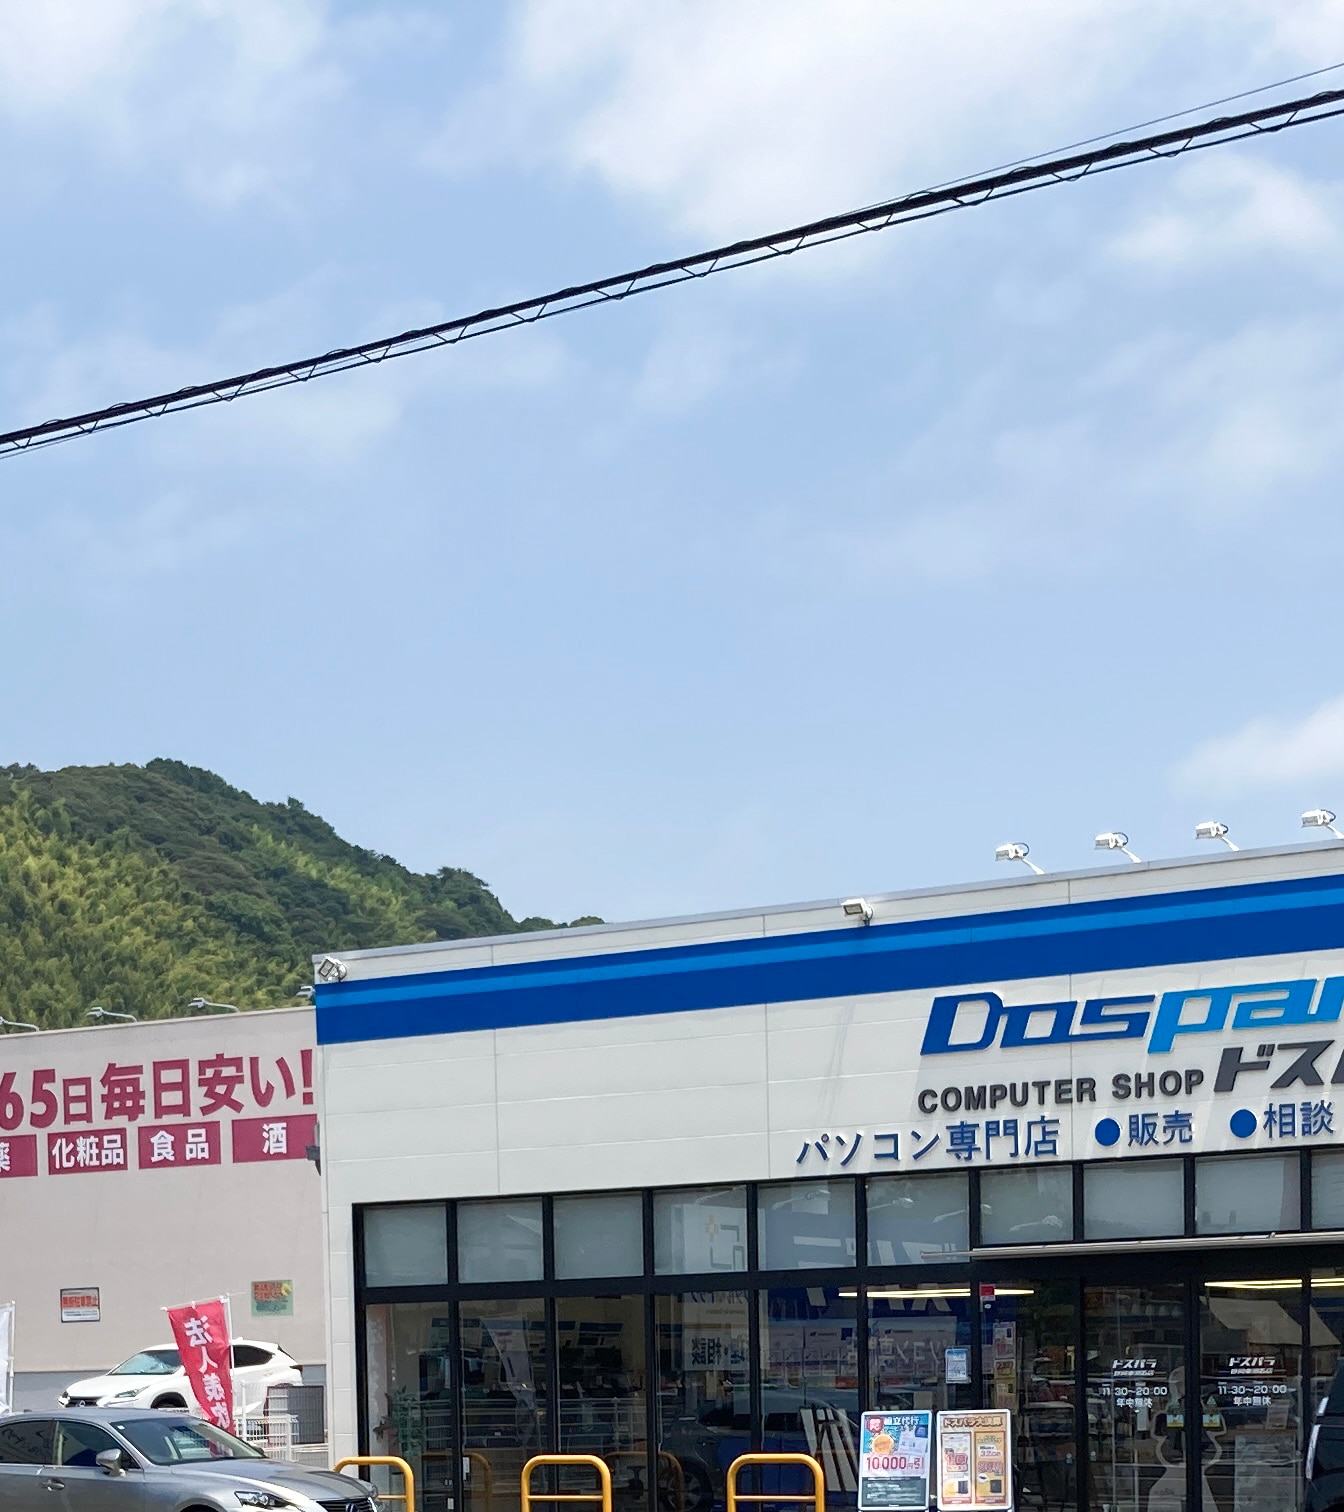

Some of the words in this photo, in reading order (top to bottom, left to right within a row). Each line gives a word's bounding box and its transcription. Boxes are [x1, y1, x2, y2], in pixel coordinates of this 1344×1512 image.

[917, 1076, 1096, 1114] COMPUTER
[1111, 1068, 1204, 1100] SHOP
[796, 1115, 1060, 1166] パソコン専門店
[1127, 1110, 1194, 1147] 販売
[1262, 1099, 1335, 1139] 相談
[52, 1134, 124, 1169] 化粧品
[150, 1128, 209, 1163] 食品
[262, 1122, 287, 1155] 酒
[1112, 1358, 1158, 1369] ドスパラ
[1228, 1356, 1276, 1367] ドスパラ
[1116, 1397, 1153, 1408] 年中無休
[1233, 1396, 1272, 1406] 年中無休
